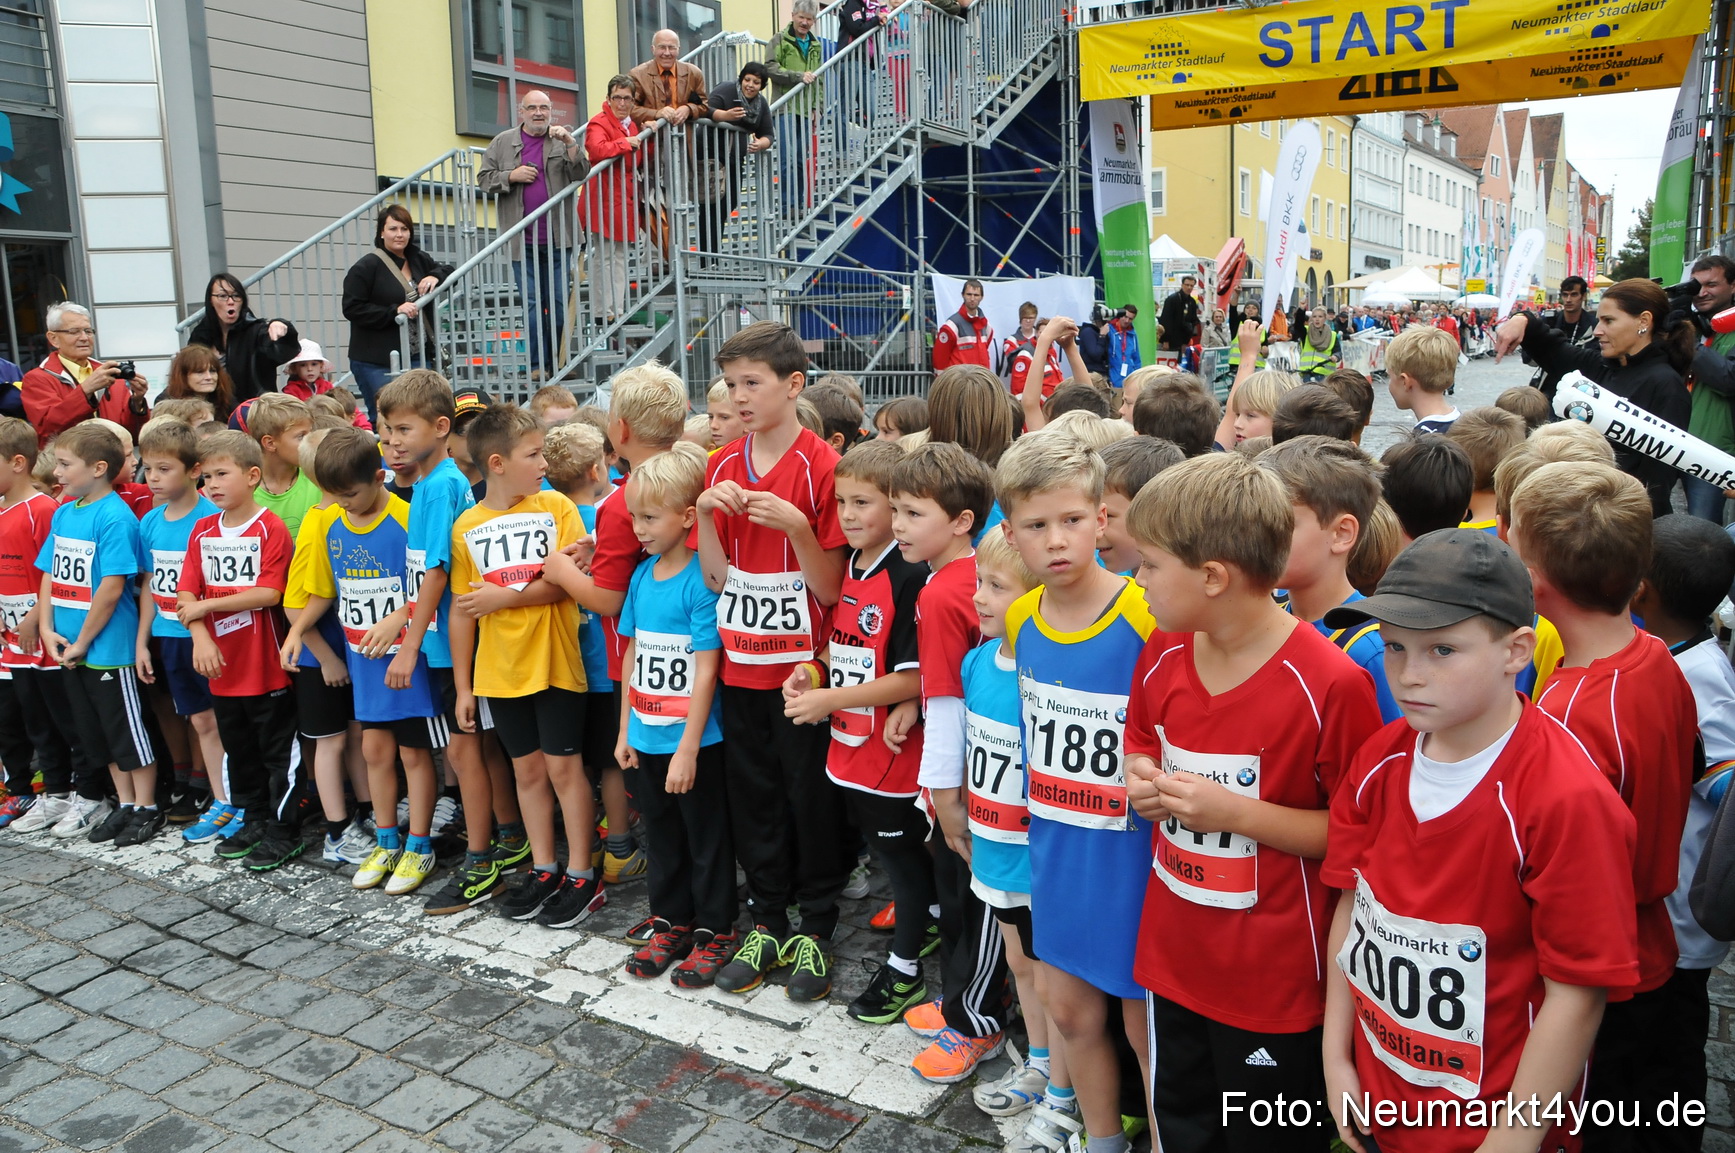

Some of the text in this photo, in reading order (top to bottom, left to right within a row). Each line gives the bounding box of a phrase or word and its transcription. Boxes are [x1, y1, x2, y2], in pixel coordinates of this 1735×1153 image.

[1510, 0, 1667, 31] Neumarkter Stadtlauf
[1258, 0, 1470, 68] START
[1109, 53, 1226, 74] Neumarkter Stadtlauf
[1530, 53, 1665, 78] Neumarkter Stadtlauf
[1275, 192, 1295, 268] Audi BKK
[1597, 237, 1606, 272] HOTE
[1506, 279, 1517, 299] Audi
[1604, 419, 1674, 461] BMW
[465, 519, 541, 538] PARTL Neumarkt
[56, 543, 83, 554] Neumarkt
[475, 530, 549, 568] 7173
[152, 568, 178, 593] 23
[207, 555, 256, 582] 7034
[500, 569, 535, 584] Robin
[349, 586, 388, 595] Neumarkt
[743, 581, 789, 593] Neumarkt
[341, 597, 396, 625] 7514
[724, 590, 802, 631] 7025
[223, 617, 240, 630] DEHN
[638, 640, 681, 653] Neumarkt
[734, 635, 787, 652] Valentin
[831, 655, 859, 666] markt
[1047, 699, 1109, 721] Neumarkt
[1030, 712, 1119, 778] 7188
[1117, 775, 1123, 784] K
[1030, 782, 1103, 810] onstantin
[970, 799, 999, 824] Leon
[1245, 845, 1251, 854] K
[1164, 845, 1205, 882] Lukas
[1371, 919, 1449, 956] Neumarkt
[1350, 918, 1466, 1031] 7008
[1467, 1029, 1474, 1040] K
[1245, 1058, 1278, 1067] adidas
